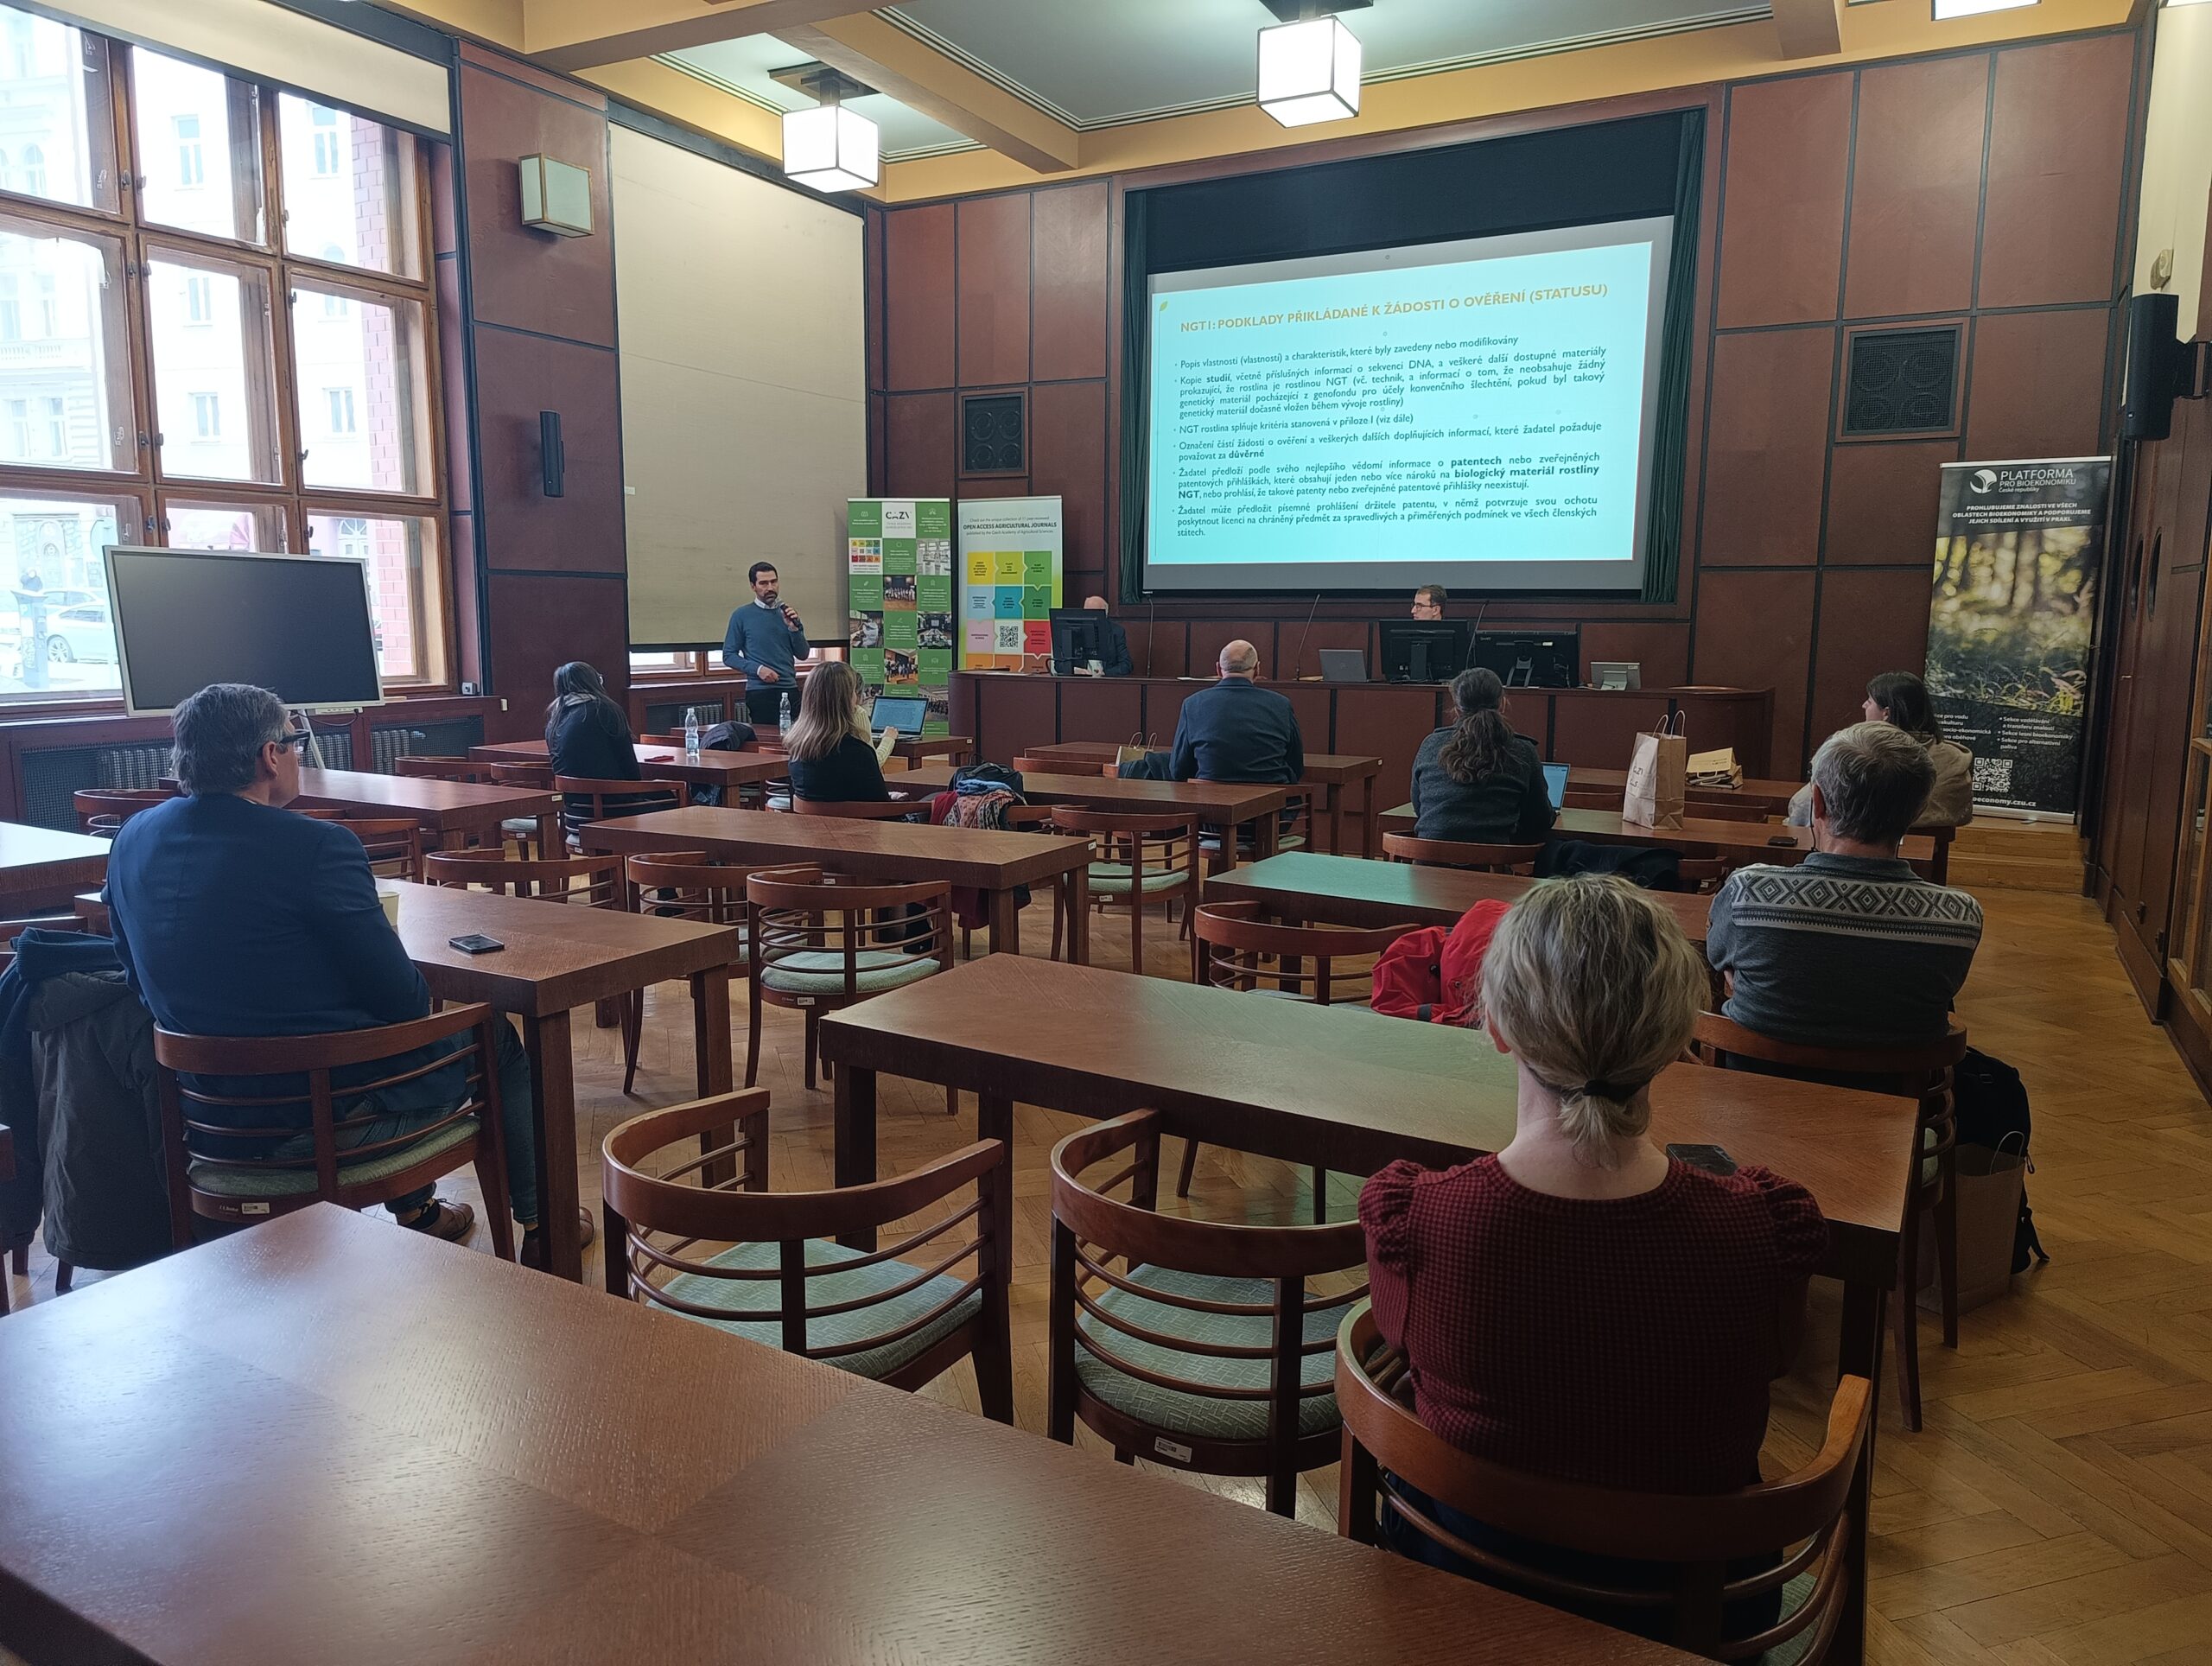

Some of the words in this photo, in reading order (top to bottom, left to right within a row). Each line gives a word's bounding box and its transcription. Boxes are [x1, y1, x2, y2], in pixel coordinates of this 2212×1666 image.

[1217, 314, 1284, 328] PODKLADY
[1287, 303, 1368, 322] PŘIKLÁDANÉ
[1372, 305, 1381, 315] K
[1383, 296, 1444, 314] ŽÁDOSTI
[1448, 297, 1459, 308] O
[1464, 289, 1525, 307] OVĚŘENÍ
[1529, 283, 1608, 303] (STATUSU)
[1180, 359, 1199, 371] Popis
[1375, 344, 1391, 356] byly
[1394, 340, 1432, 354] zavedeny
[1434, 339, 1457, 349] nebo
[1180, 375, 1201, 387] Kopie
[1368, 360, 1402, 372] sekvenci
[1408, 358, 1433, 370] DNA,
[1239, 382, 1268, 391] rostlina
[1325, 376, 1347, 386] NGT
[1352, 374, 1367, 386] (vč.
[1371, 372, 1404, 385] technik,
[1478, 366, 1498, 377] tom,
[1362, 388, 1376, 397] pro
[1382, 384, 1404, 397] účely
[1517, 374, 1546, 388] pokud
[1553, 373, 1566, 385] byl
[1573, 371, 1605, 385] takový
[1179, 424, 1198, 434] NGT
[1201, 423, 1228, 432] rostlina
[1231, 421, 1257, 433] splňuje
[1376, 414, 1390, 425] (viz
[1522, 423, 1554, 433] žadatel
[1559, 420, 1601, 434] požaduje
[1179, 466, 1205, 476] Žadatel
[1249, 465, 1270, 476] podle
[1509, 454, 1532, 463] nebo
[1334, 473, 1357, 484] jeden
[1361, 472, 1382, 480] nebo
[1559, 463, 1599, 476] rostliny
[2000, 468, 2074, 480] PLATFORMA
[1178, 504, 1205, 514] Žadatel
[1211, 505, 1231, 513] může
[1364, 500, 1395, 509] držitele
[1402, 499, 1437, 511] patentu,
[1564, 494, 1597, 504] ochotu
[1972, 797, 2037, 807] oeconomy.czu.cz
